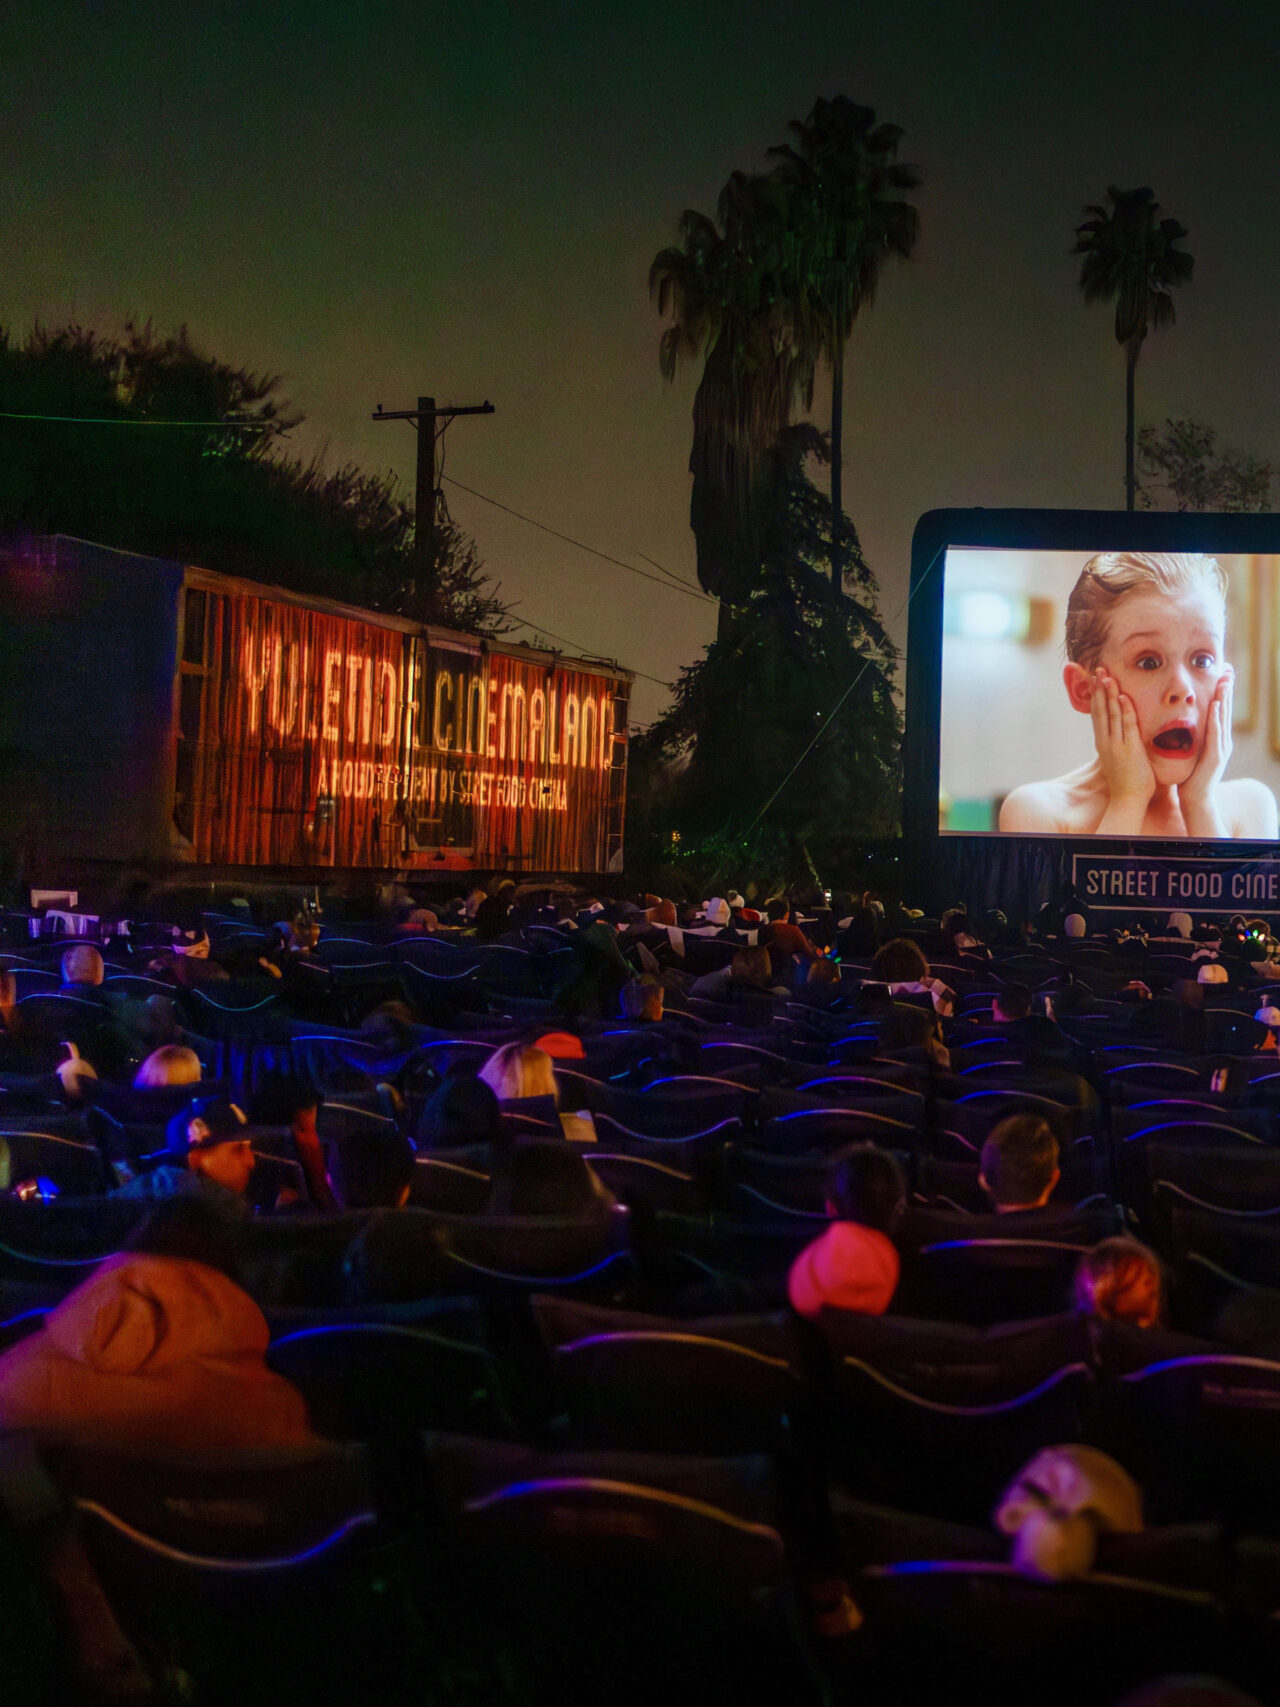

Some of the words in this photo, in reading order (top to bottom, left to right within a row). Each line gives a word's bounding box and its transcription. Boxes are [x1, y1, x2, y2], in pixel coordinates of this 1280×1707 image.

[434, 669, 614, 770] CINEMALAND
[317, 757, 328, 796] A
[440, 769, 455, 804] BY
[496, 774, 526, 808] FOOD
[1086, 869, 1159, 897] STREET
[1168, 872, 1223, 898] FOOD
